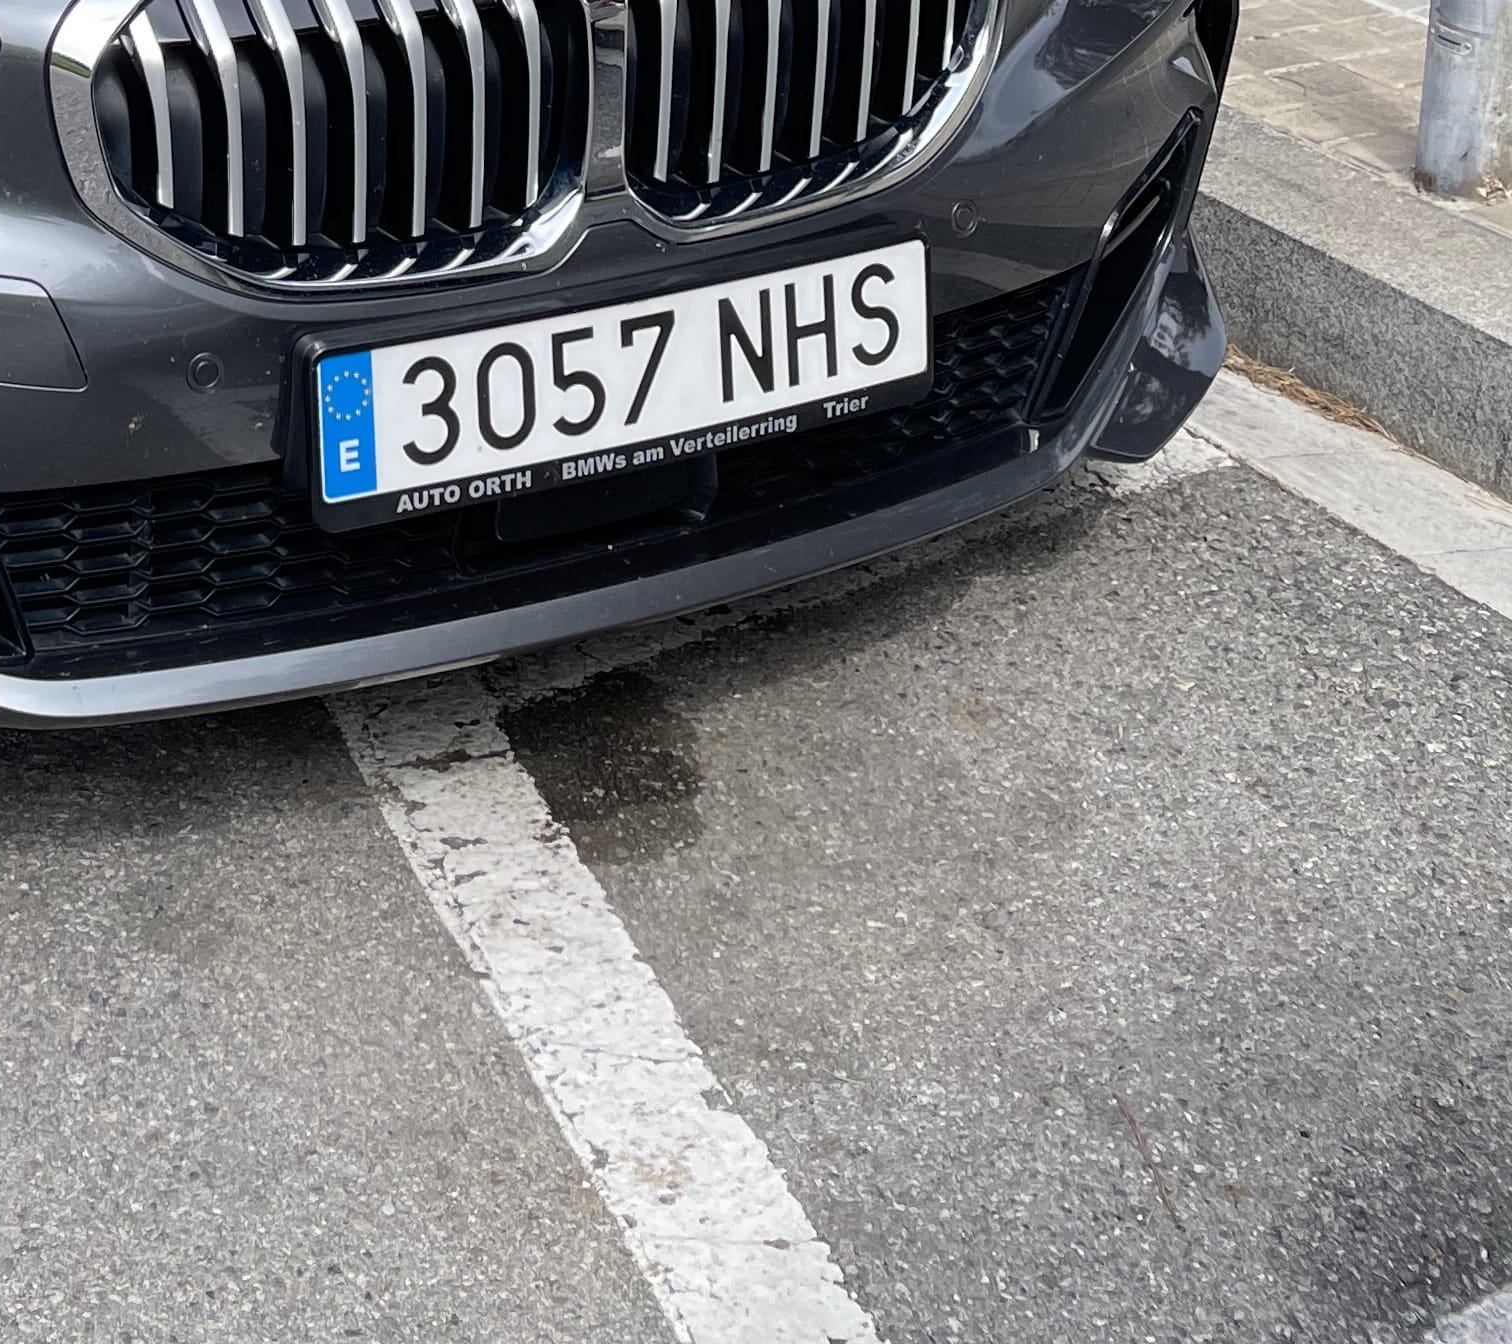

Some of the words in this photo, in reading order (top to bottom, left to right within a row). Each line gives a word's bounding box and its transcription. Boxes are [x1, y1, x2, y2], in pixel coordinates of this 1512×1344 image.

[401, 309, 675, 467] 3057
[719, 262, 900, 404] NHS
[339, 437, 361, 473] E
[395, 484, 461, 514] AUTO
[468, 469, 532, 499] ORTH
[561, 451, 627, 481] BMWs
[632, 445, 664, 465] am
[669, 413, 798, 457] Verteilerring
[823, 395, 869, 419] Trier
